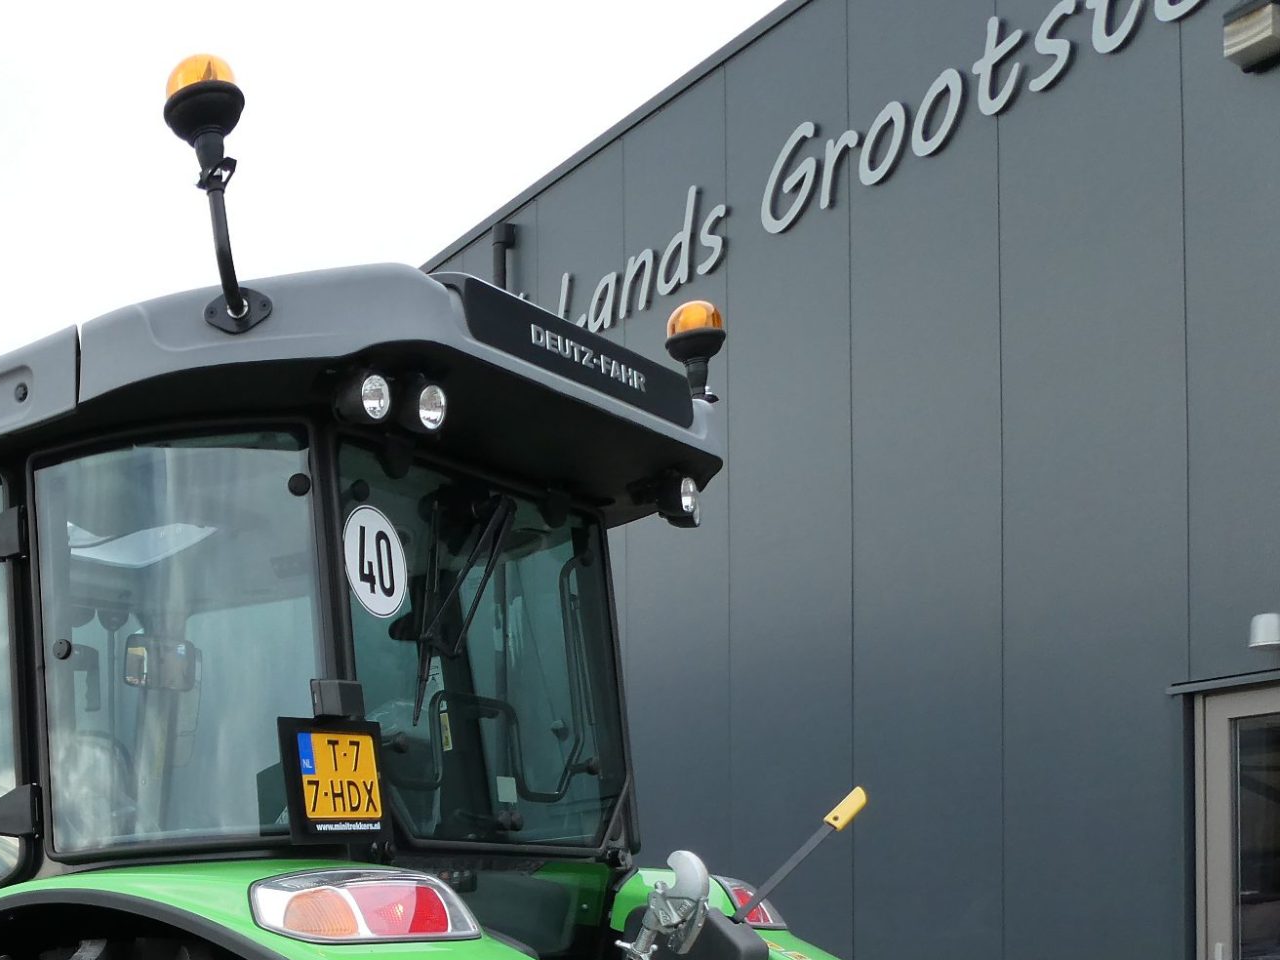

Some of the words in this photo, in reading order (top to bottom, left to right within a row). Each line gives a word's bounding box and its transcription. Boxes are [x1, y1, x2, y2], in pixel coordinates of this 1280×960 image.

[558, 186, 727, 334] Lands
[530, 322, 647, 393] DEUTZ-FAHR
[358, 525, 396, 599] 40
[302, 758, 313, 769] NL
[306, 780, 378, 813] 7-HDX
[315, 821, 382, 831] www.minitrekkers.nl
